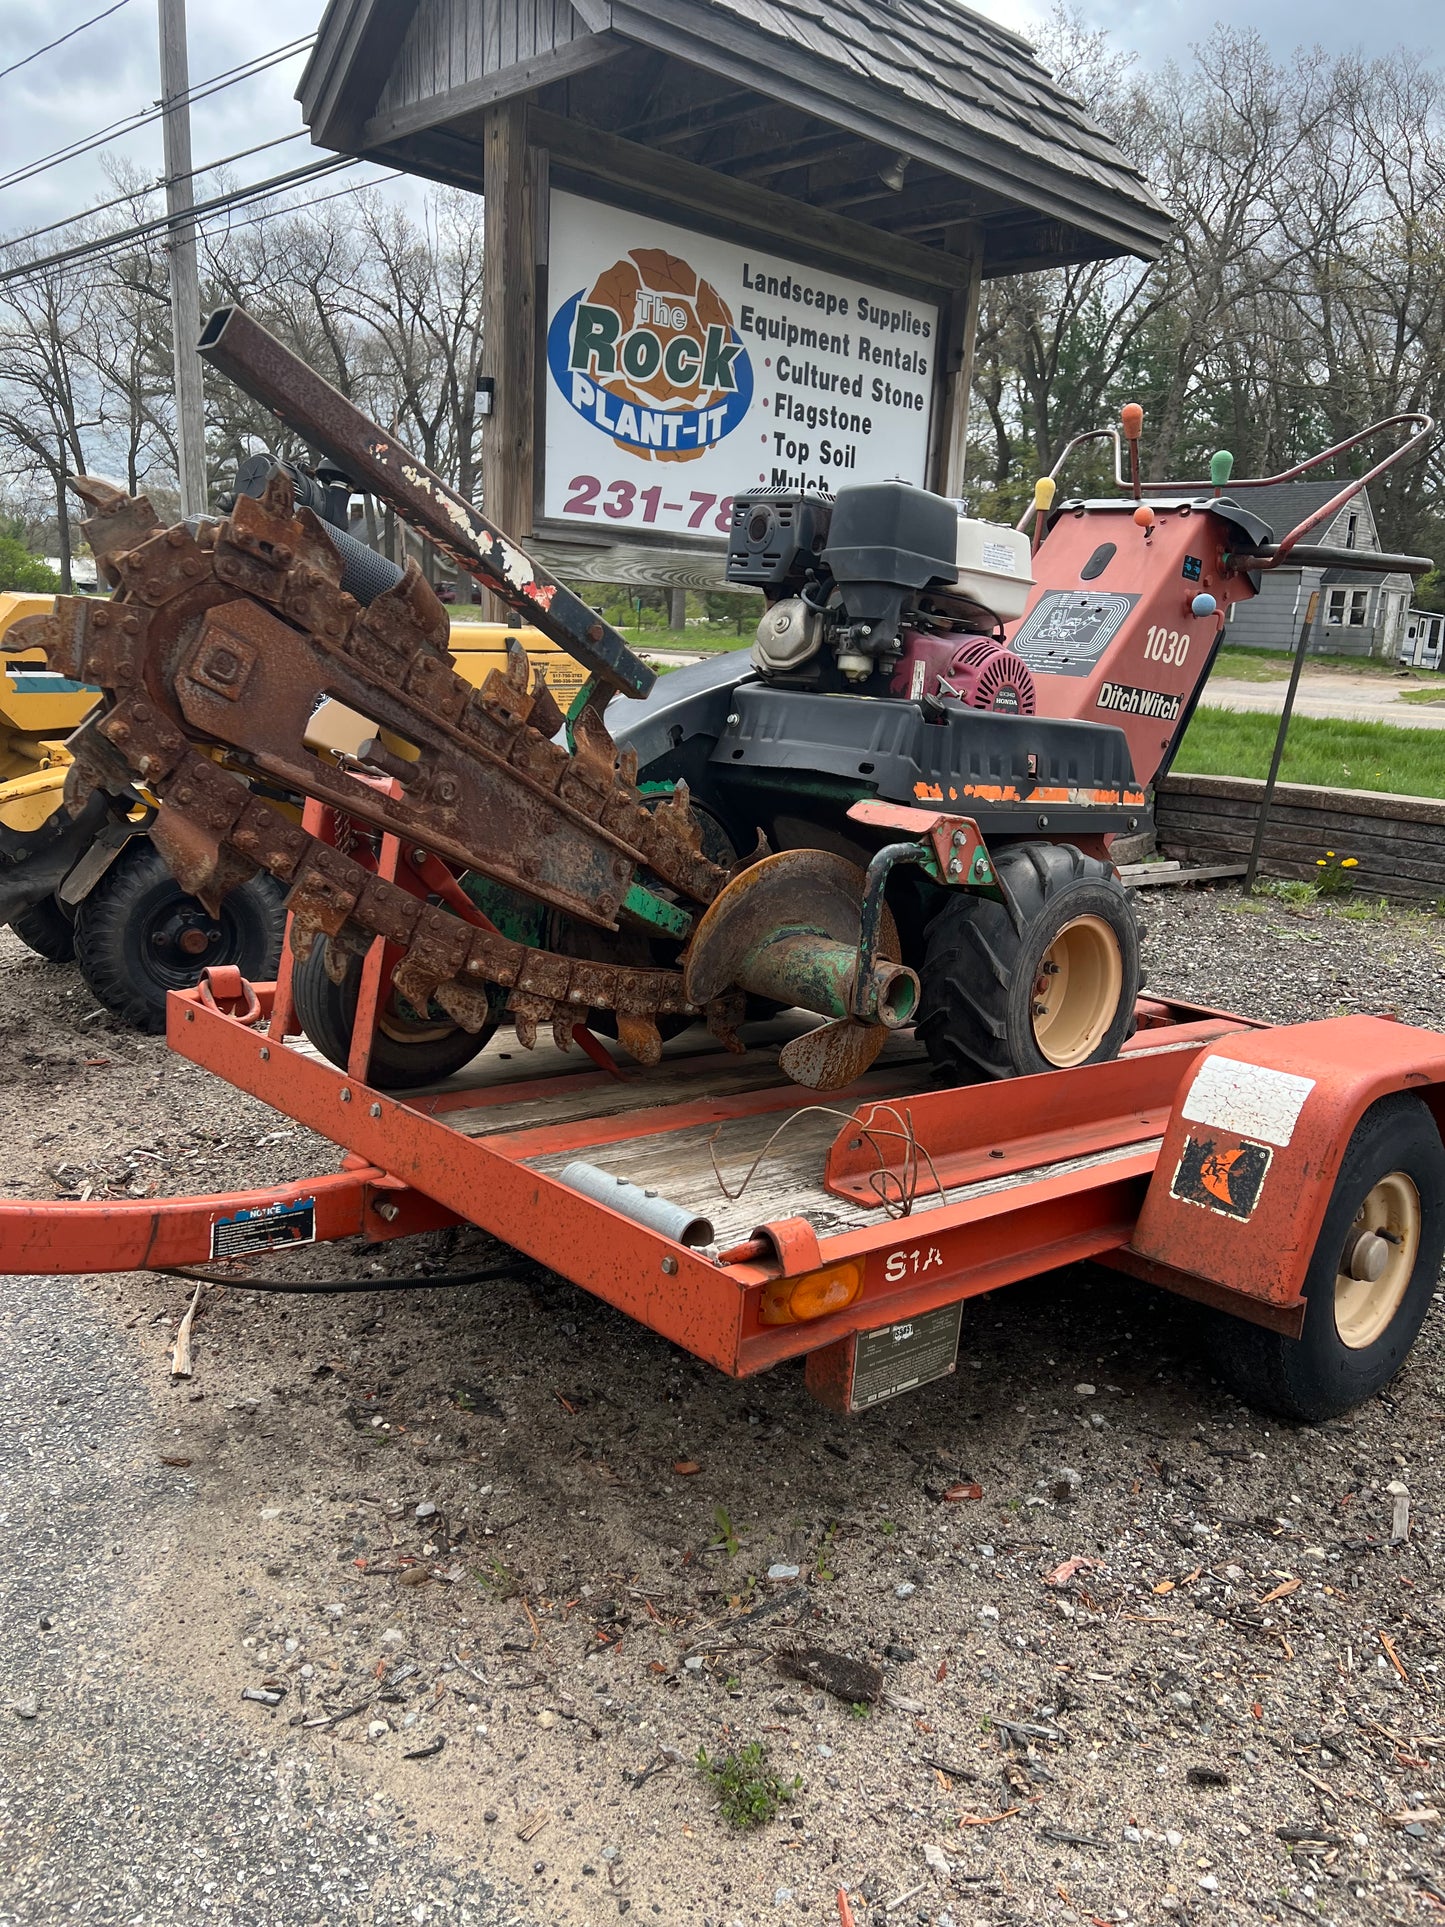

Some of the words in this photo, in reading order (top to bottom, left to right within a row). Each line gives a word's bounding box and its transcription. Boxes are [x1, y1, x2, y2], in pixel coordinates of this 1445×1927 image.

[637, 290, 687, 331] The
[742, 263, 849, 316] Landscape
[857, 297, 931, 338] Supplies
[570, 302, 743, 391] Rock
[740, 305, 850, 357] Equipment
[858, 336, 928, 376] Rentals
[776, 355, 864, 398] Cultured
[871, 378, 924, 412] Stone
[571, 371, 729, 448] PLANT-IT
[774, 392, 872, 435] Flagstone
[773, 431, 810, 465] Top
[819, 440, 856, 469] Soil
[1143, 625, 1191, 667] 1030
[995, 697, 1018, 706] HONDA
[249, 1205, 281, 1218] NOTICE
